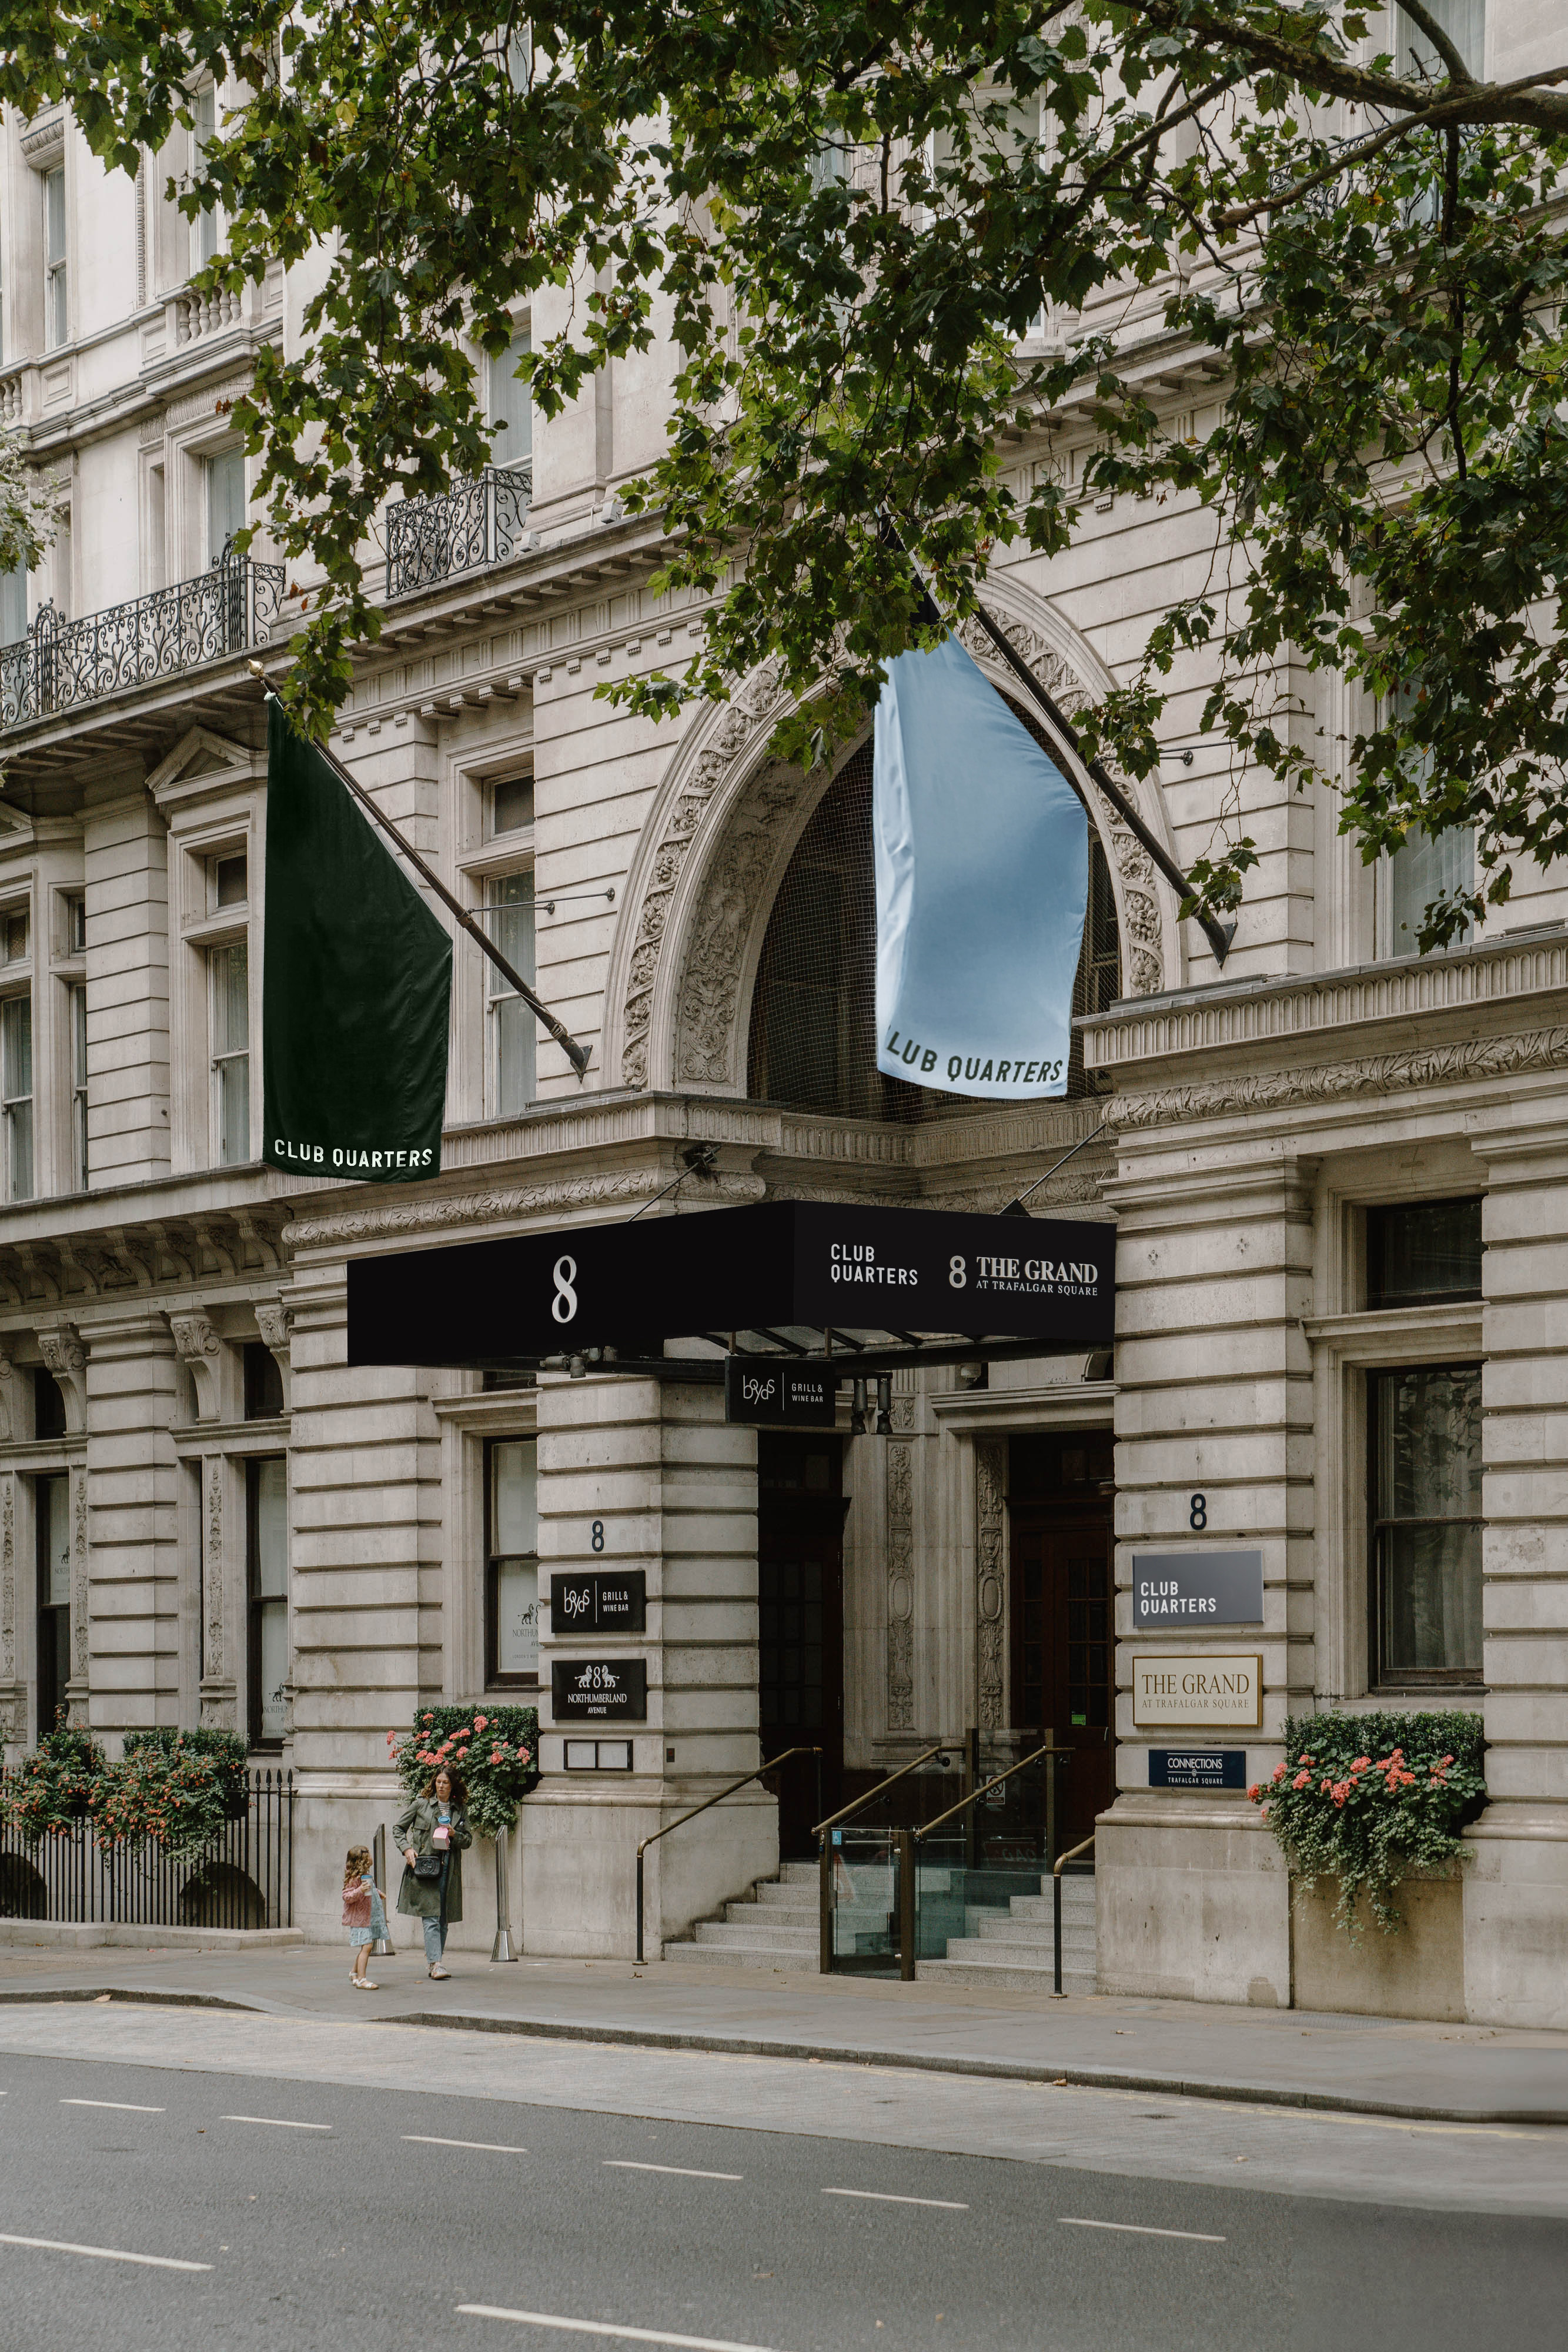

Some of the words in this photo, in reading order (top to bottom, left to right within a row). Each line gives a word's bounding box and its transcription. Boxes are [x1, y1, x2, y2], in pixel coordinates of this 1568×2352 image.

[887, 1025, 938, 1072] LUB
[947, 1055, 1063, 1083] QUARTERS
[275, 1139, 324, 1162] CLUB
[333, 1148, 433, 1167] QUARTERS
[831, 1244, 875, 1262] CLUB
[831, 1264, 918, 1285] QUARTERS
[949, 1255, 967, 1288] 8
[976, 1257, 1020, 1278] THE
[1024, 1259, 1098, 1284] GRAND
[551, 1255, 577, 1323] 8
[976, 1280, 988, 1289] AT
[992, 1281, 1054, 1293] TRAFALGAR
[1058, 1285, 1098, 1296] SQUARE
[791, 1383, 816, 1392] GRILL
[817, 1384, 823, 1392] &
[1189, 1493, 1208, 1530] 8
[591, 1520, 604, 1552] 8
[603, 1591, 622, 1601] GRILL
[623, 1591, 628, 1600] &
[1141, 1581, 1178, 1596] CLUB
[1141, 1598, 1216, 1616] QUARTERS
[593, 1666, 601, 1688] 8
[1142, 1674, 1177, 1694] THE
[1182, 1673, 1249, 1694] GRAND
[568, 1693, 627, 1703] NORTHUMBERLAND
[1142, 1699, 1153, 1708] AT
[1156, 1699, 1208, 1708] TRAFALGAR
[1213, 1699, 1249, 1709] SQUARE
[1168, 1758, 1223, 1769] CONNECTIONS
